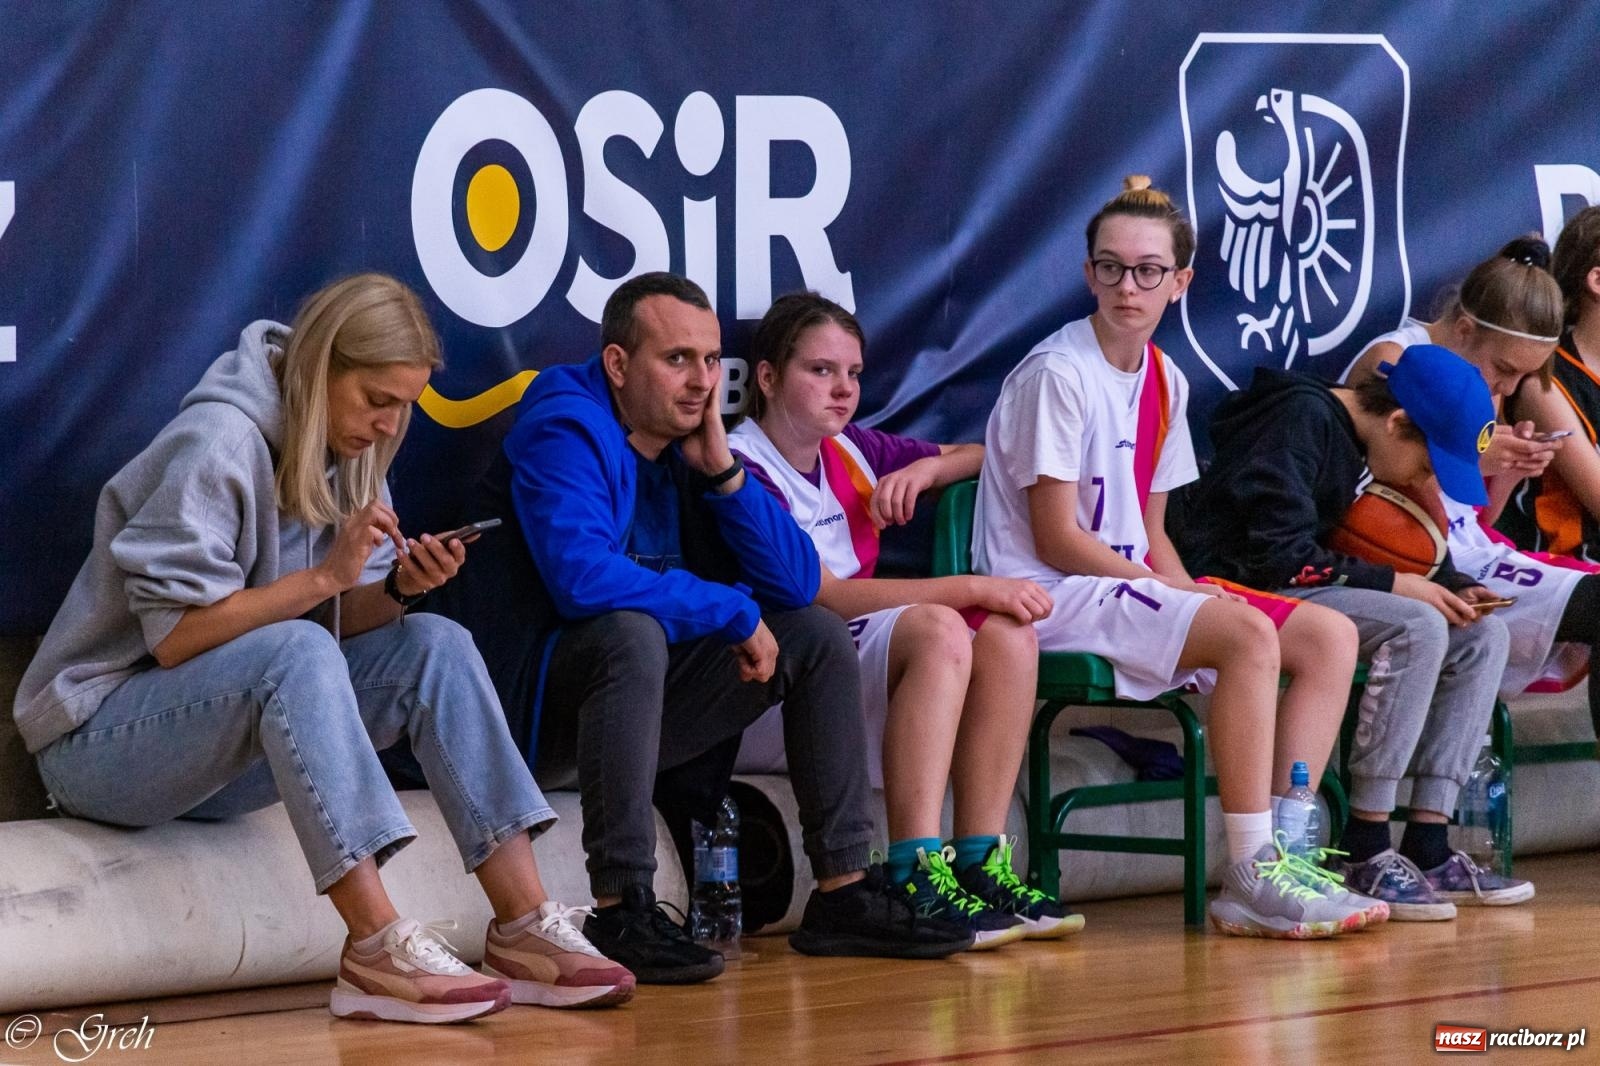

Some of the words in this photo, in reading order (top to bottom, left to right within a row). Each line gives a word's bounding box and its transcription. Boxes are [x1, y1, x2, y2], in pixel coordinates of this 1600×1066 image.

[1091, 477, 1104, 531] 7
[1492, 562, 1544, 587] 5
[1114, 582, 1162, 612] 7
